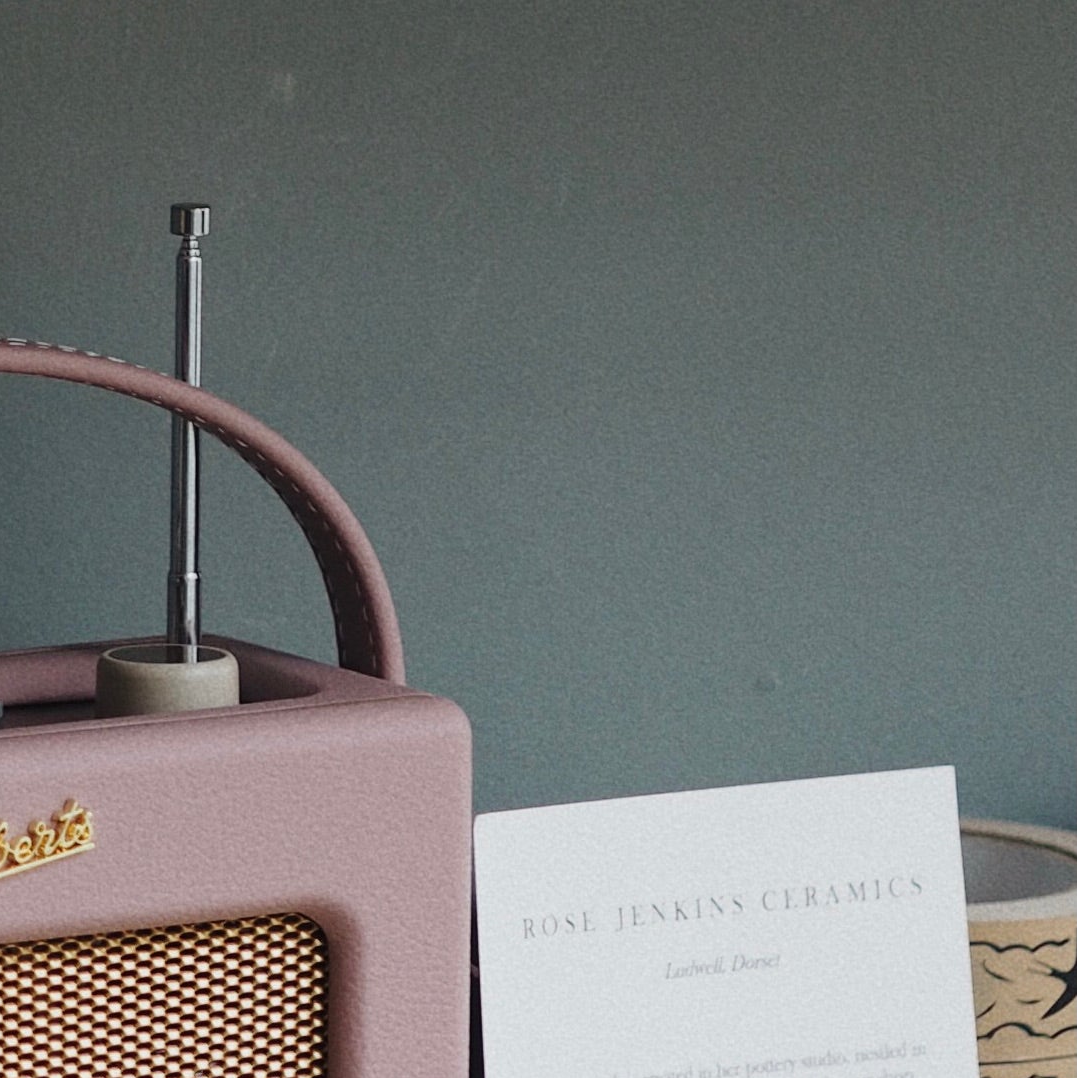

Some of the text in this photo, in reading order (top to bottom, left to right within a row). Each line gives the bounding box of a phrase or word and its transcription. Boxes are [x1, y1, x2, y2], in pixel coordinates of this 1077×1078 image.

[522, 876, 922, 938] ROSE JENKINS CERAMICS
[732, 950, 780, 971] Dorset
[716, 1059, 740, 1078] her
[746, 1057, 795, 1078] pottery
